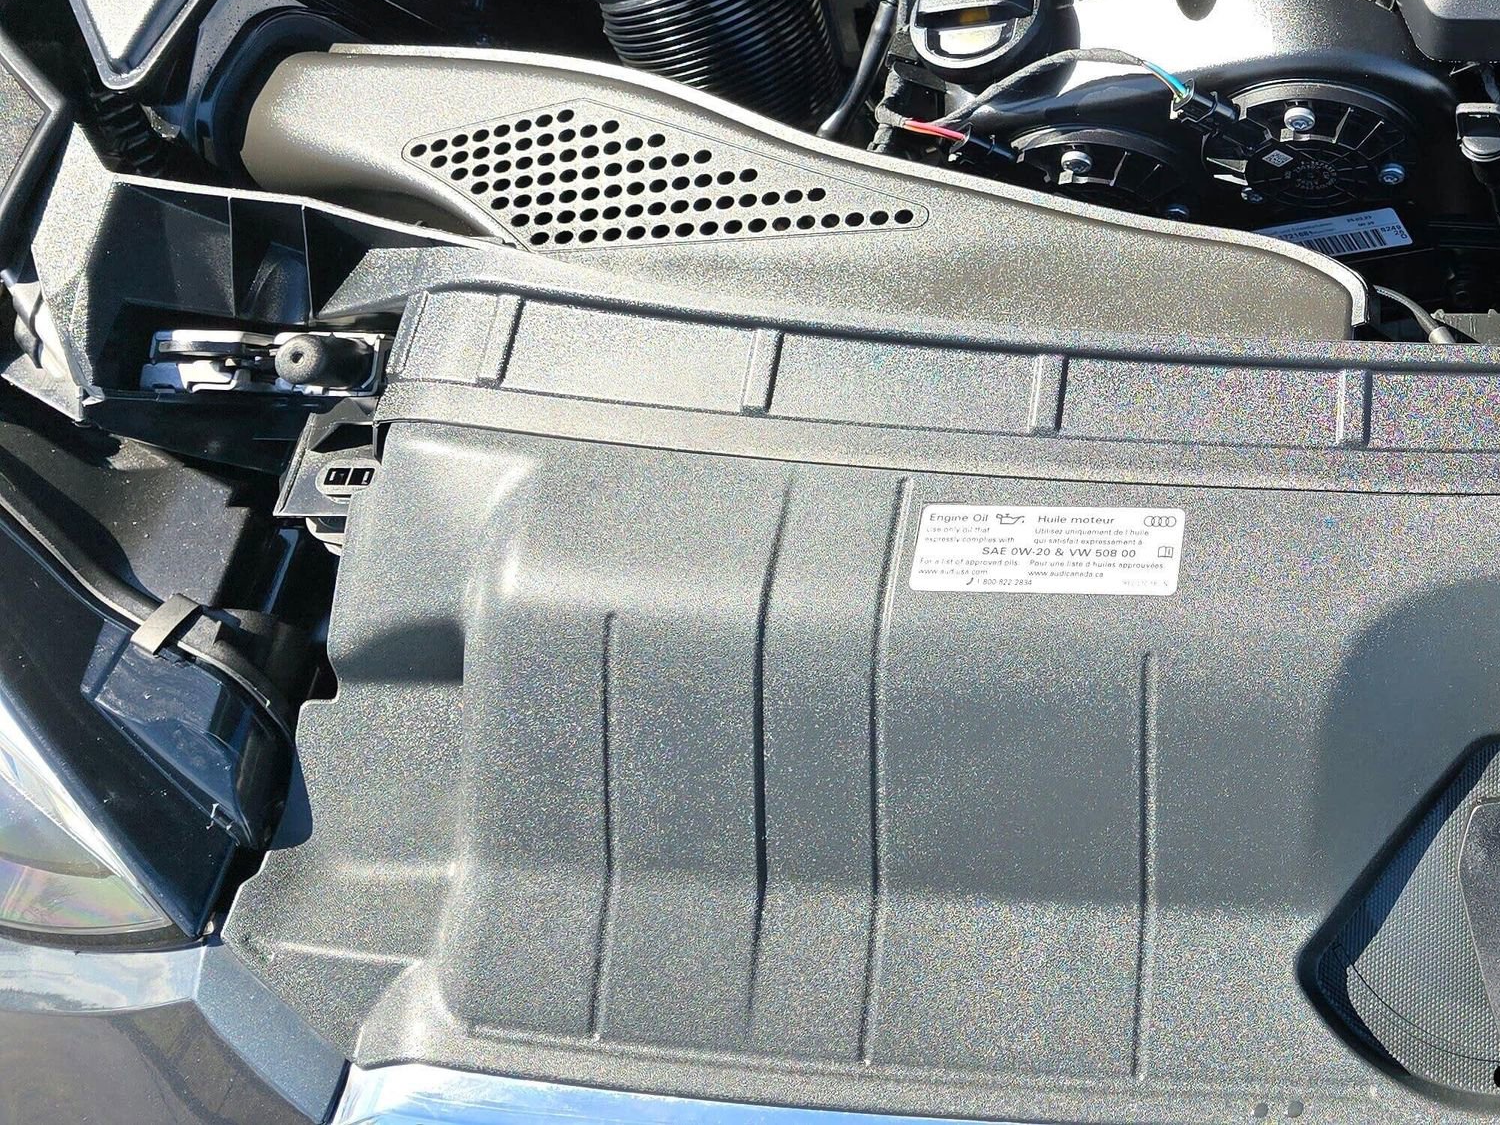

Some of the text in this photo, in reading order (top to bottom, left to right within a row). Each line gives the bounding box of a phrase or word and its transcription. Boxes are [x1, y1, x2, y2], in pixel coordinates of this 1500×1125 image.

[930, 513, 988, 523] Engine Oil
[1038, 515, 1115, 525] Huile moteur
[982, 547, 1136, 558] SAE 0W-20 & VW 508 00
[965, 559, 1002, 567] approved
